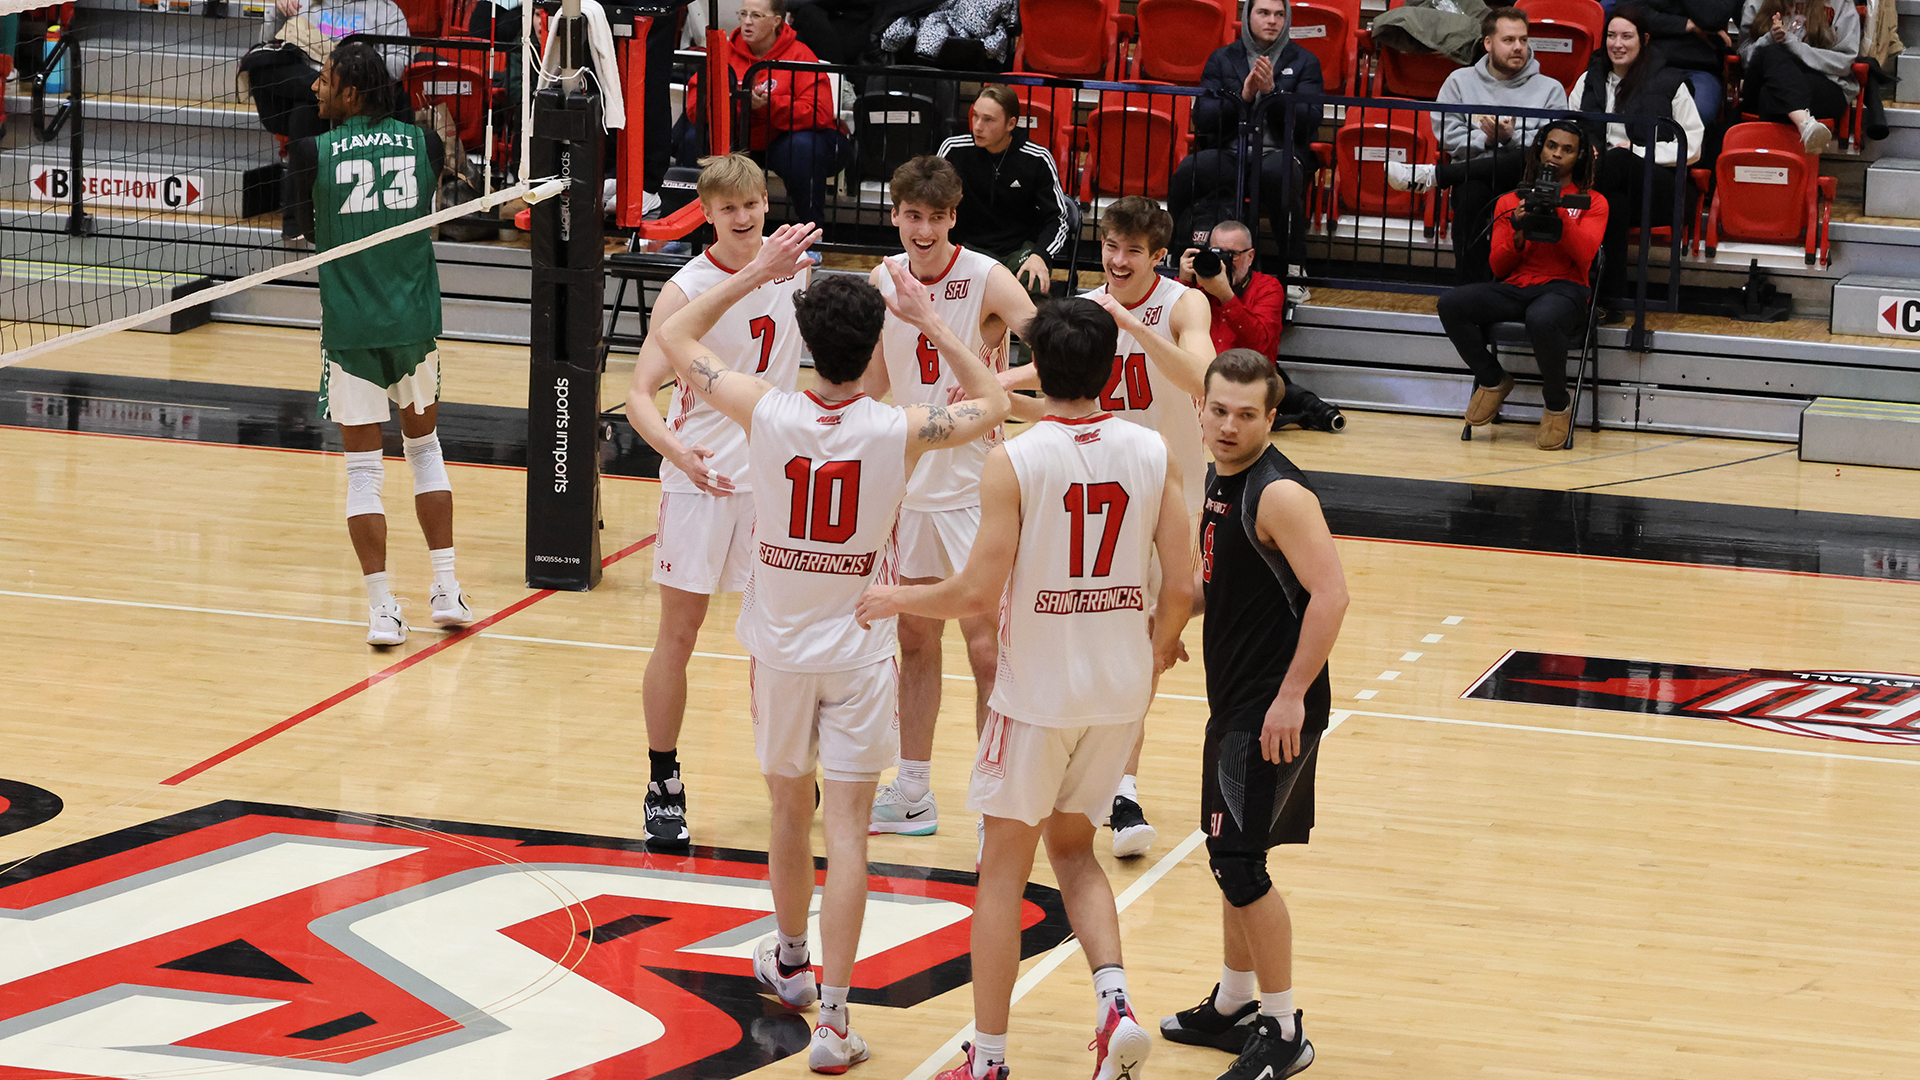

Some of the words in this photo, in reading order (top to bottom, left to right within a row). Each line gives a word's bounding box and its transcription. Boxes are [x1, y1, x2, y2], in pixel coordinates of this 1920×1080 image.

[51, 169, 69, 198] B
[80, 177, 156, 199] SECTION
[163, 176, 182, 207] C
[336, 155, 418, 214] 23
[561, 151, 571, 190] spors
[945, 279, 971, 300] SFU
[1902, 300, 1920, 333] C
[749, 314, 776, 374] 7
[916, 331, 940, 385] 6
[554, 377, 570, 429] sports
[1099, 352, 1153, 412] 20
[552, 431, 569, 493] imports
[784, 455, 861, 544] 10
[1063, 481, 1130, 578] 17
[759, 543, 799, 569] SAINT
[797, 551, 869, 575] FRANCIS
[1035, 591, 1078, 614] SAINT
[1075, 586, 1143, 613] FRANCIS
